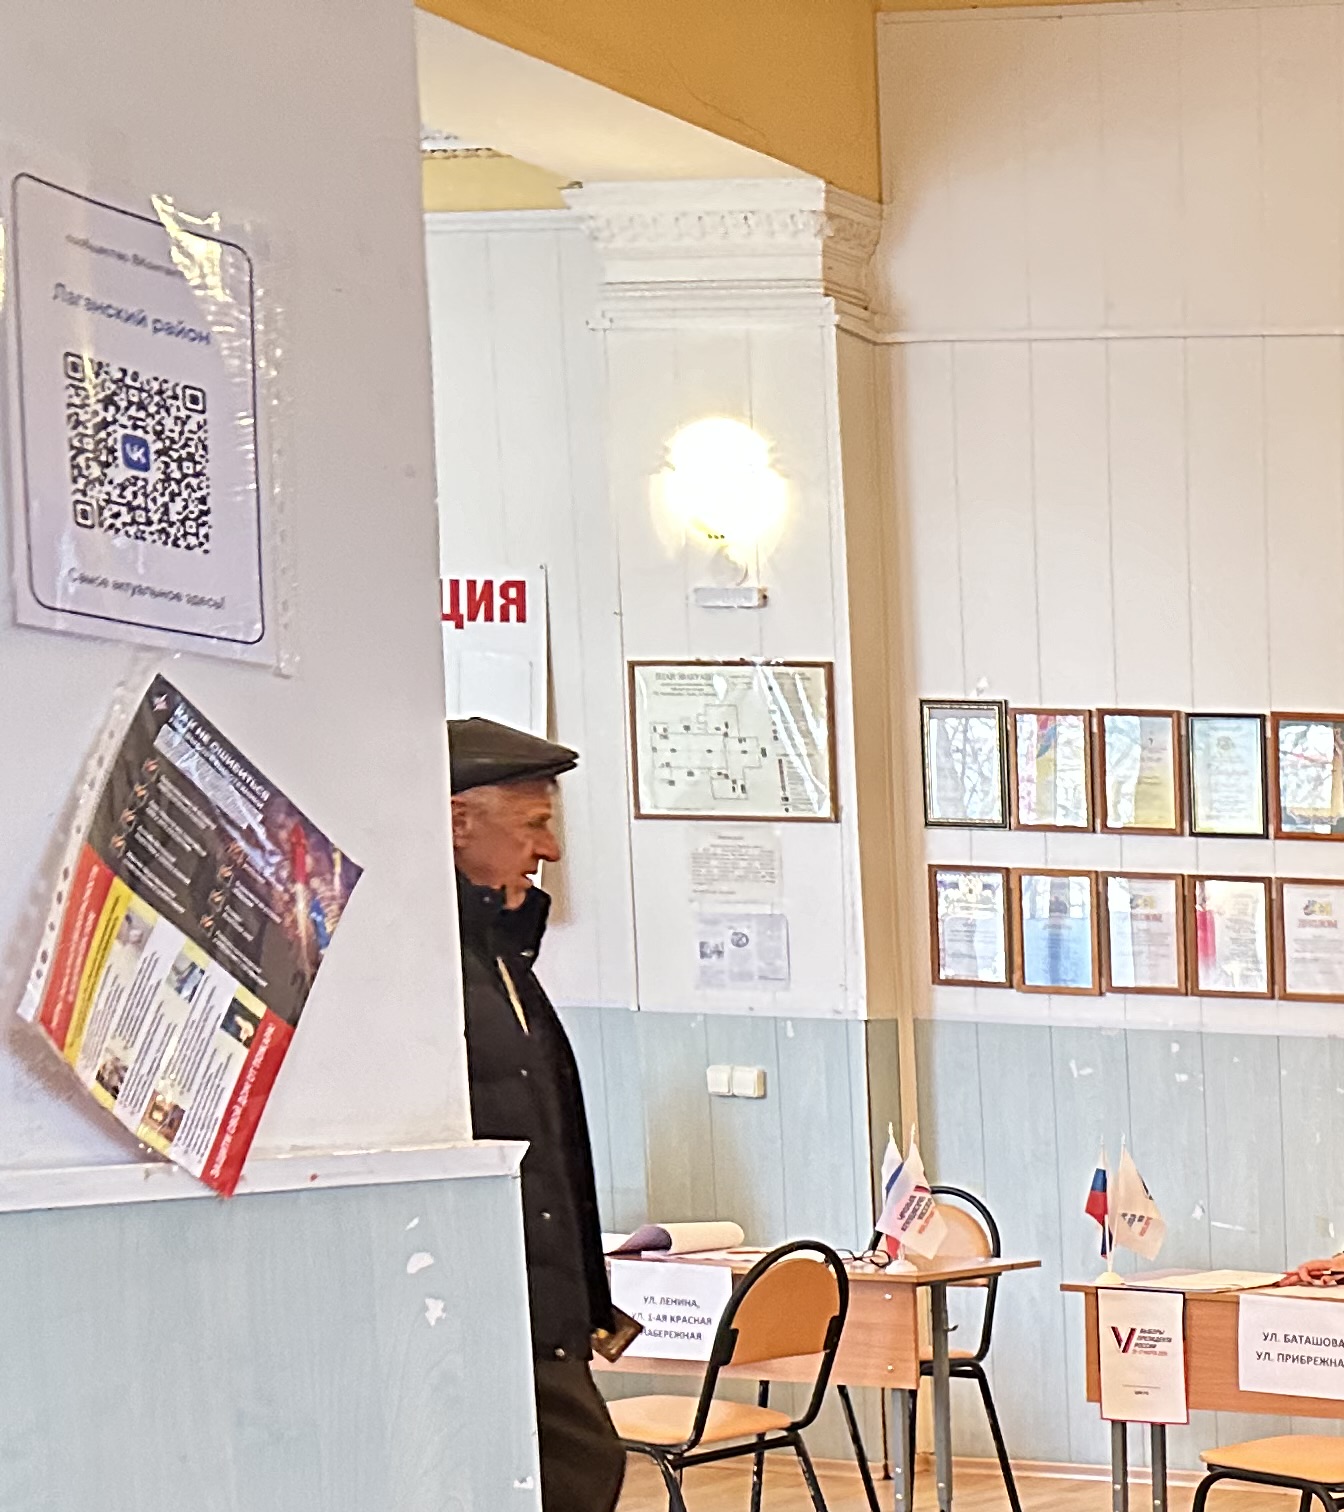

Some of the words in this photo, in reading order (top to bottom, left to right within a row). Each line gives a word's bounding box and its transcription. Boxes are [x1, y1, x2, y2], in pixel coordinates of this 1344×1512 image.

[151, 317, 212, 346] район
[670, 1315, 712, 1326] КРАСНАЯ
[1262, 1331, 1281, 1343] УЛ.
[1255, 1350, 1276, 1362] УЛ.
